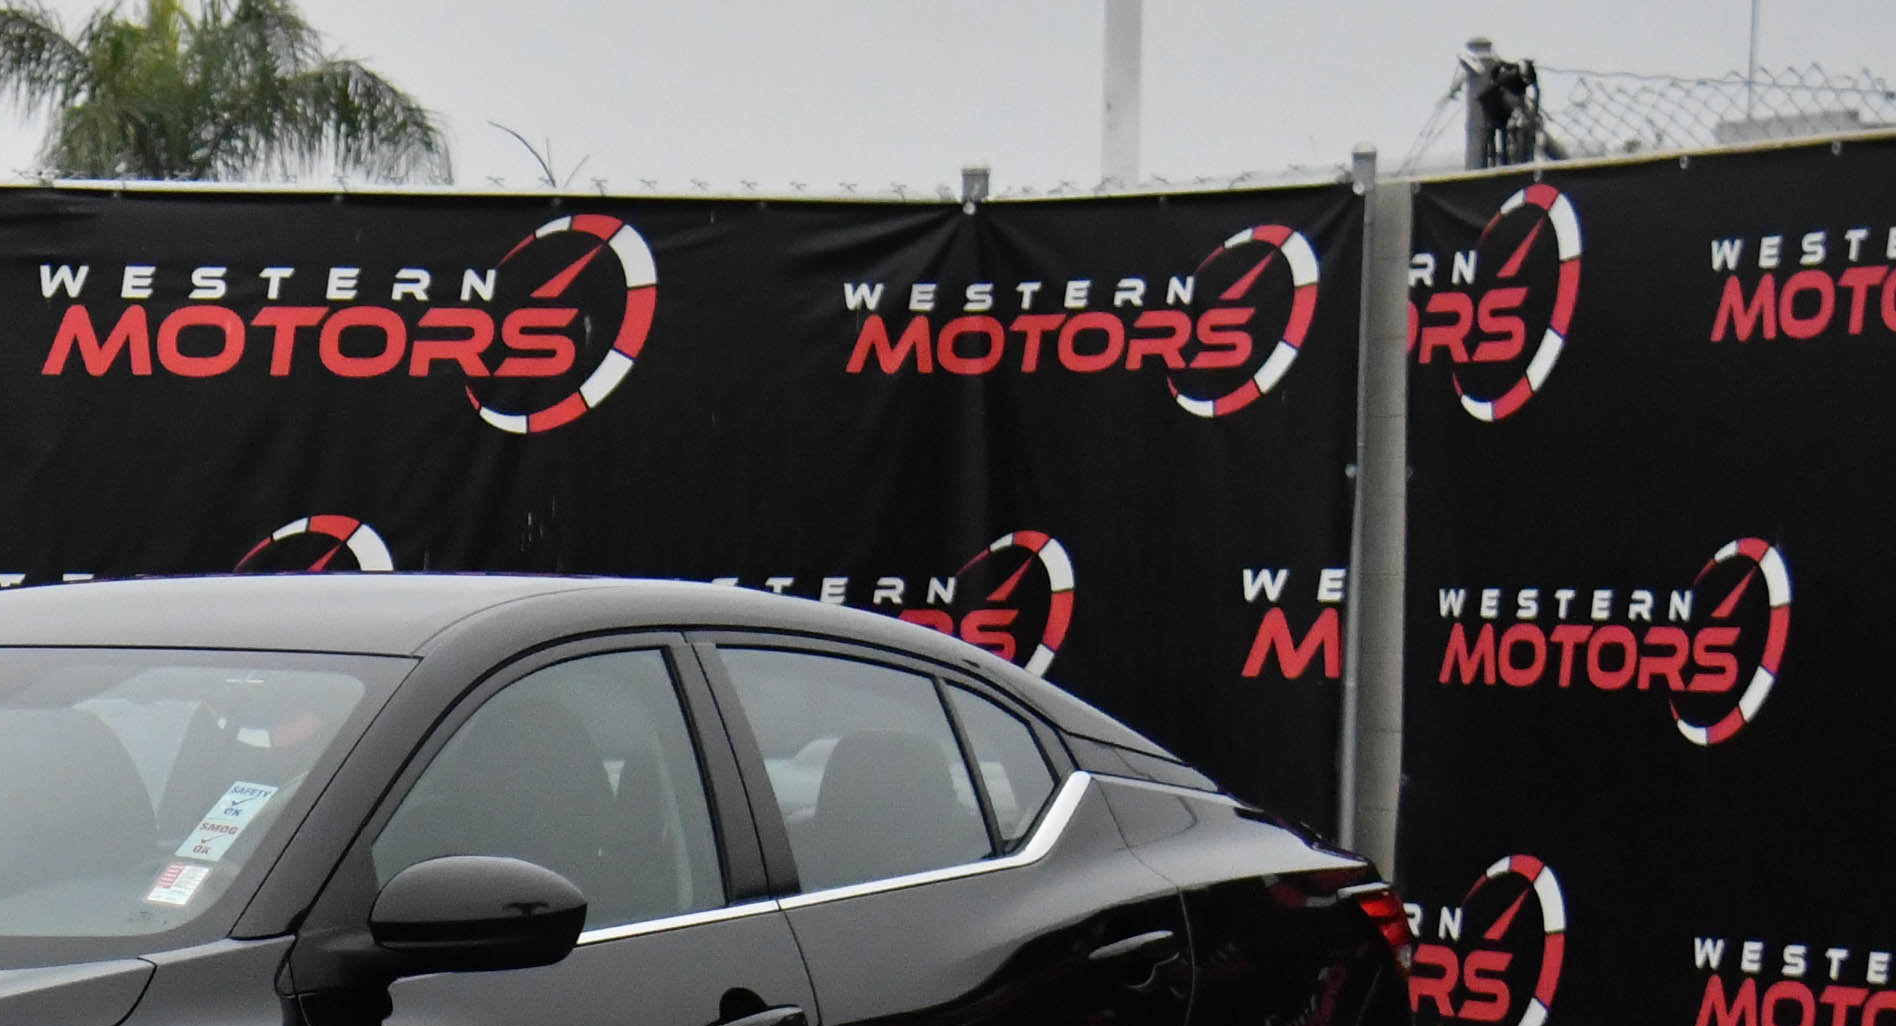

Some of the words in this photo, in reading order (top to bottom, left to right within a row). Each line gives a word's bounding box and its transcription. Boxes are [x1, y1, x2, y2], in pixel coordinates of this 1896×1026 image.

[40, 264, 497, 301] WESTERN
[843, 276, 1196, 311] WESTERN
[1710, 265, 1896, 343] MOT
[41, 303, 579, 378] MOTORS
[846, 307, 1256, 375] MOTORS
[1407, 286, 1528, 364] RS
[1439, 588, 1693, 621] WESTERN
[1439, 622, 1742, 693] MOTORS
[231, 785, 272, 798] SAFETY
[199, 822, 238, 835] SMOG
[223, 807, 243, 817] OK
